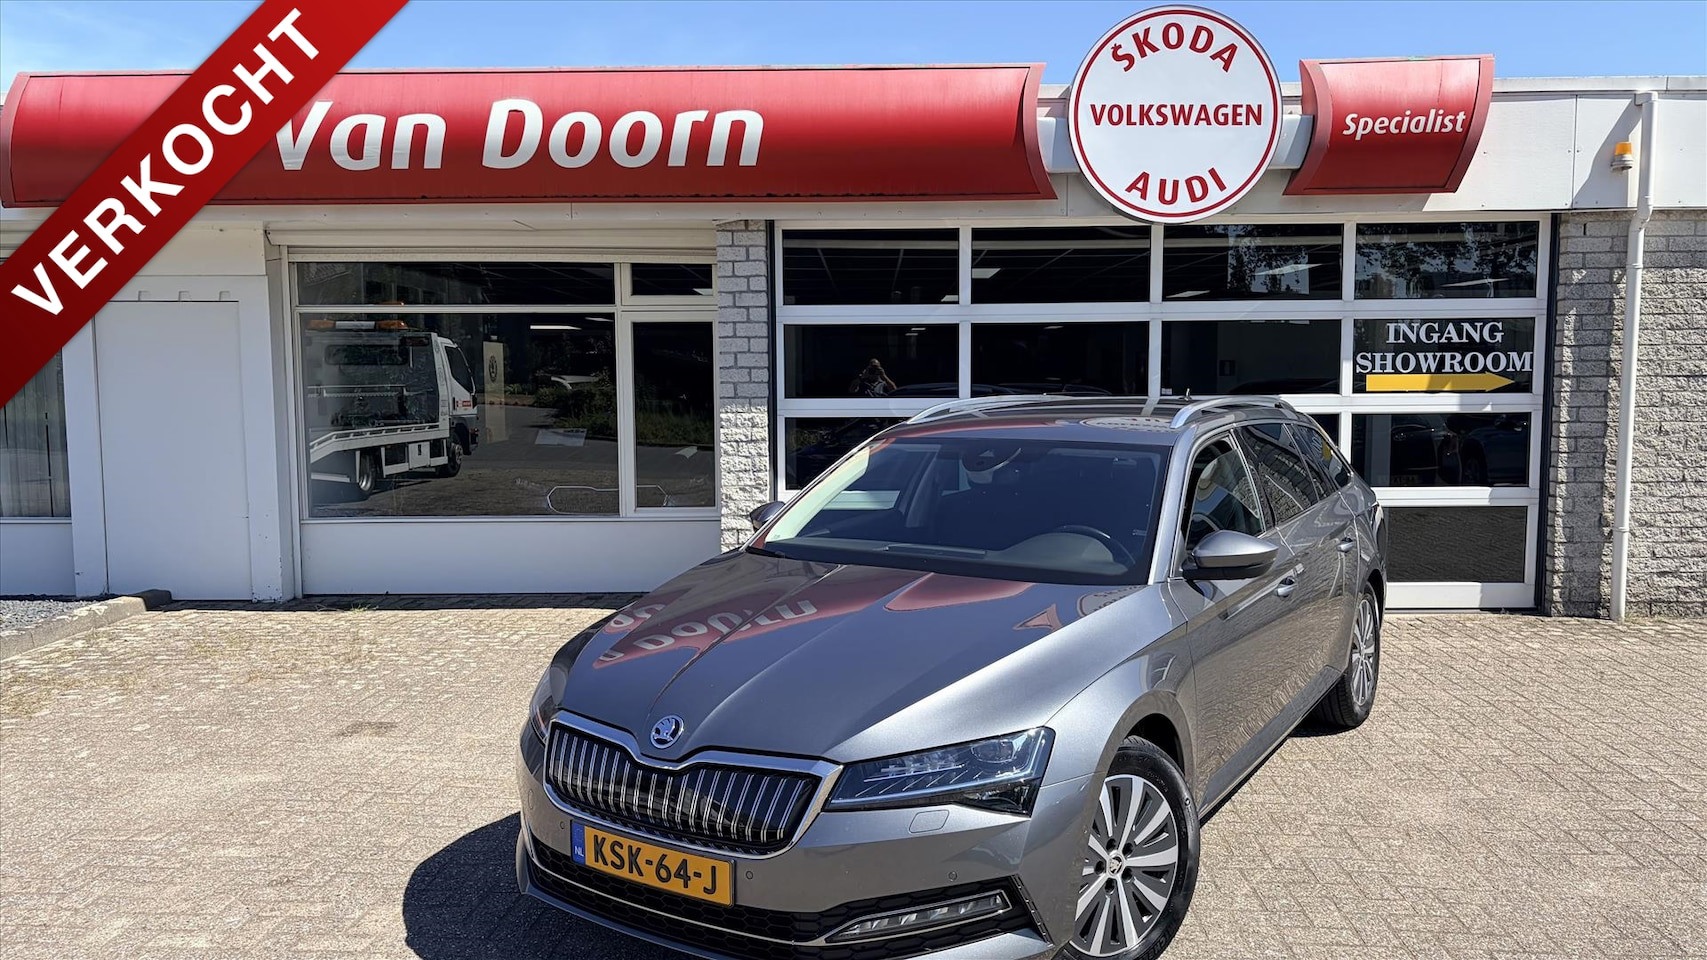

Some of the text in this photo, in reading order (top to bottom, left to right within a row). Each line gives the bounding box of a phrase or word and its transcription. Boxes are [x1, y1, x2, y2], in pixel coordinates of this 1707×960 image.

[1111, 22, 1238, 72] ŠKODA
[1090, 104, 1263, 126] VOLKSWAGEN
[1342, 108, 1466, 140] Specialist
[276, 98, 764, 171] Van Doorn
[1124, 167, 1227, 205] AUDI
[1386, 322, 1504, 344] INGANG
[1356, 351, 1533, 373] SHOWROOM
[574, 845, 585, 857] NL
[593, 834, 717, 895] KSK-64-J
